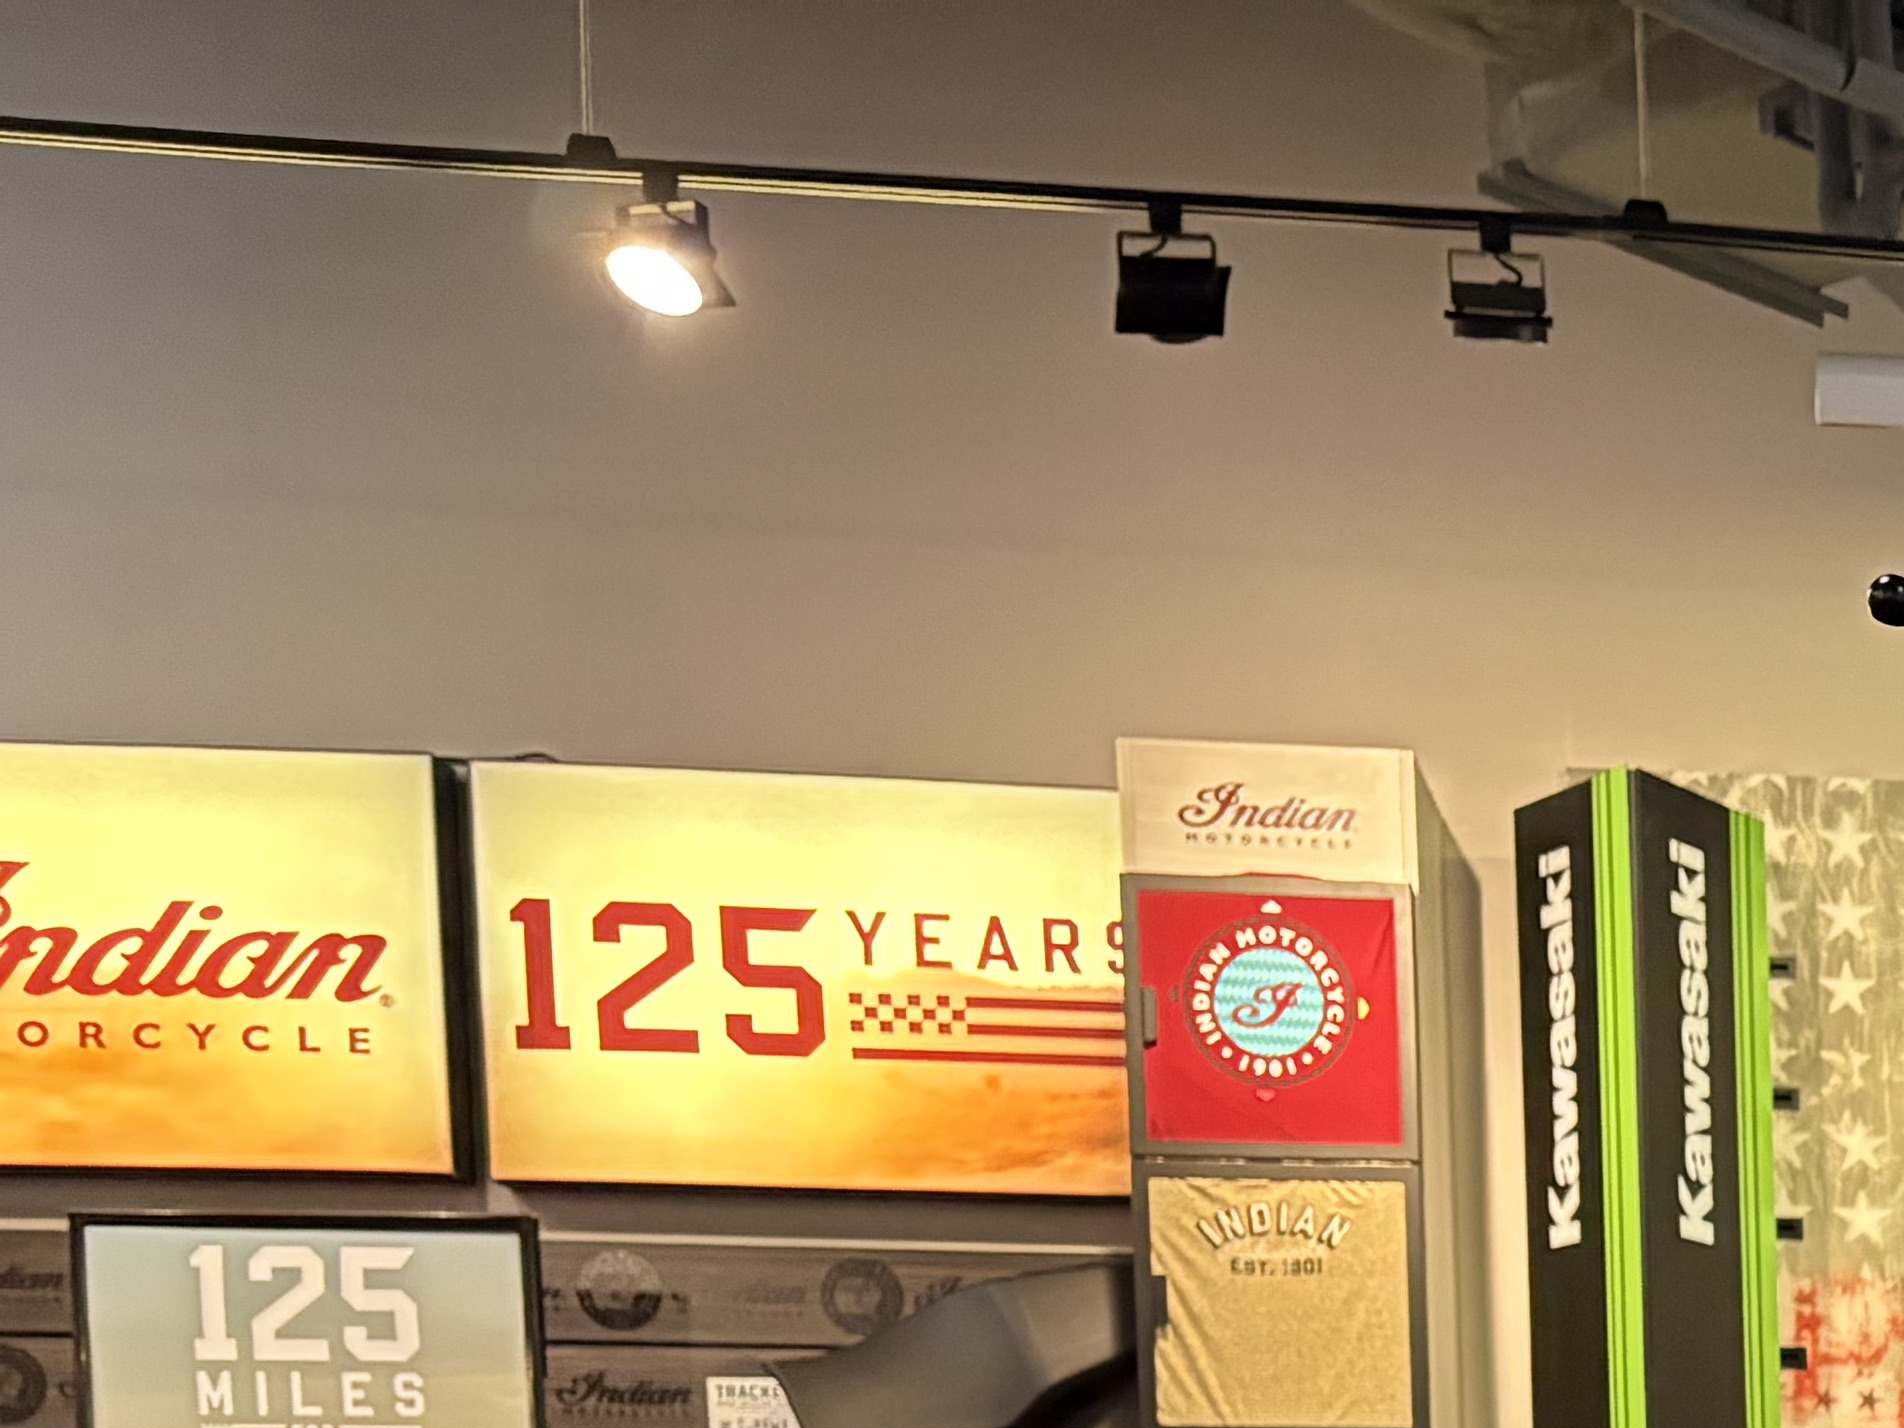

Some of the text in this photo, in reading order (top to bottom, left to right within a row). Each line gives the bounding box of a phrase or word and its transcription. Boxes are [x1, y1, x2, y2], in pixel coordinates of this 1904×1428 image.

[1178, 782, 1356, 831] Indian
[510, 897, 826, 1057] 125
[1193, 925, 1344, 1055] INDIAN MOTORCYCLE
[1538, 845, 1582, 1249] Kawasaki
[1669, 838, 1715, 1246] Kawasaki
[1196, 1201, 1351, 1250] INDIAN
[189, 1244, 421, 1363] 125
[196, 1370, 426, 1418] MILES
